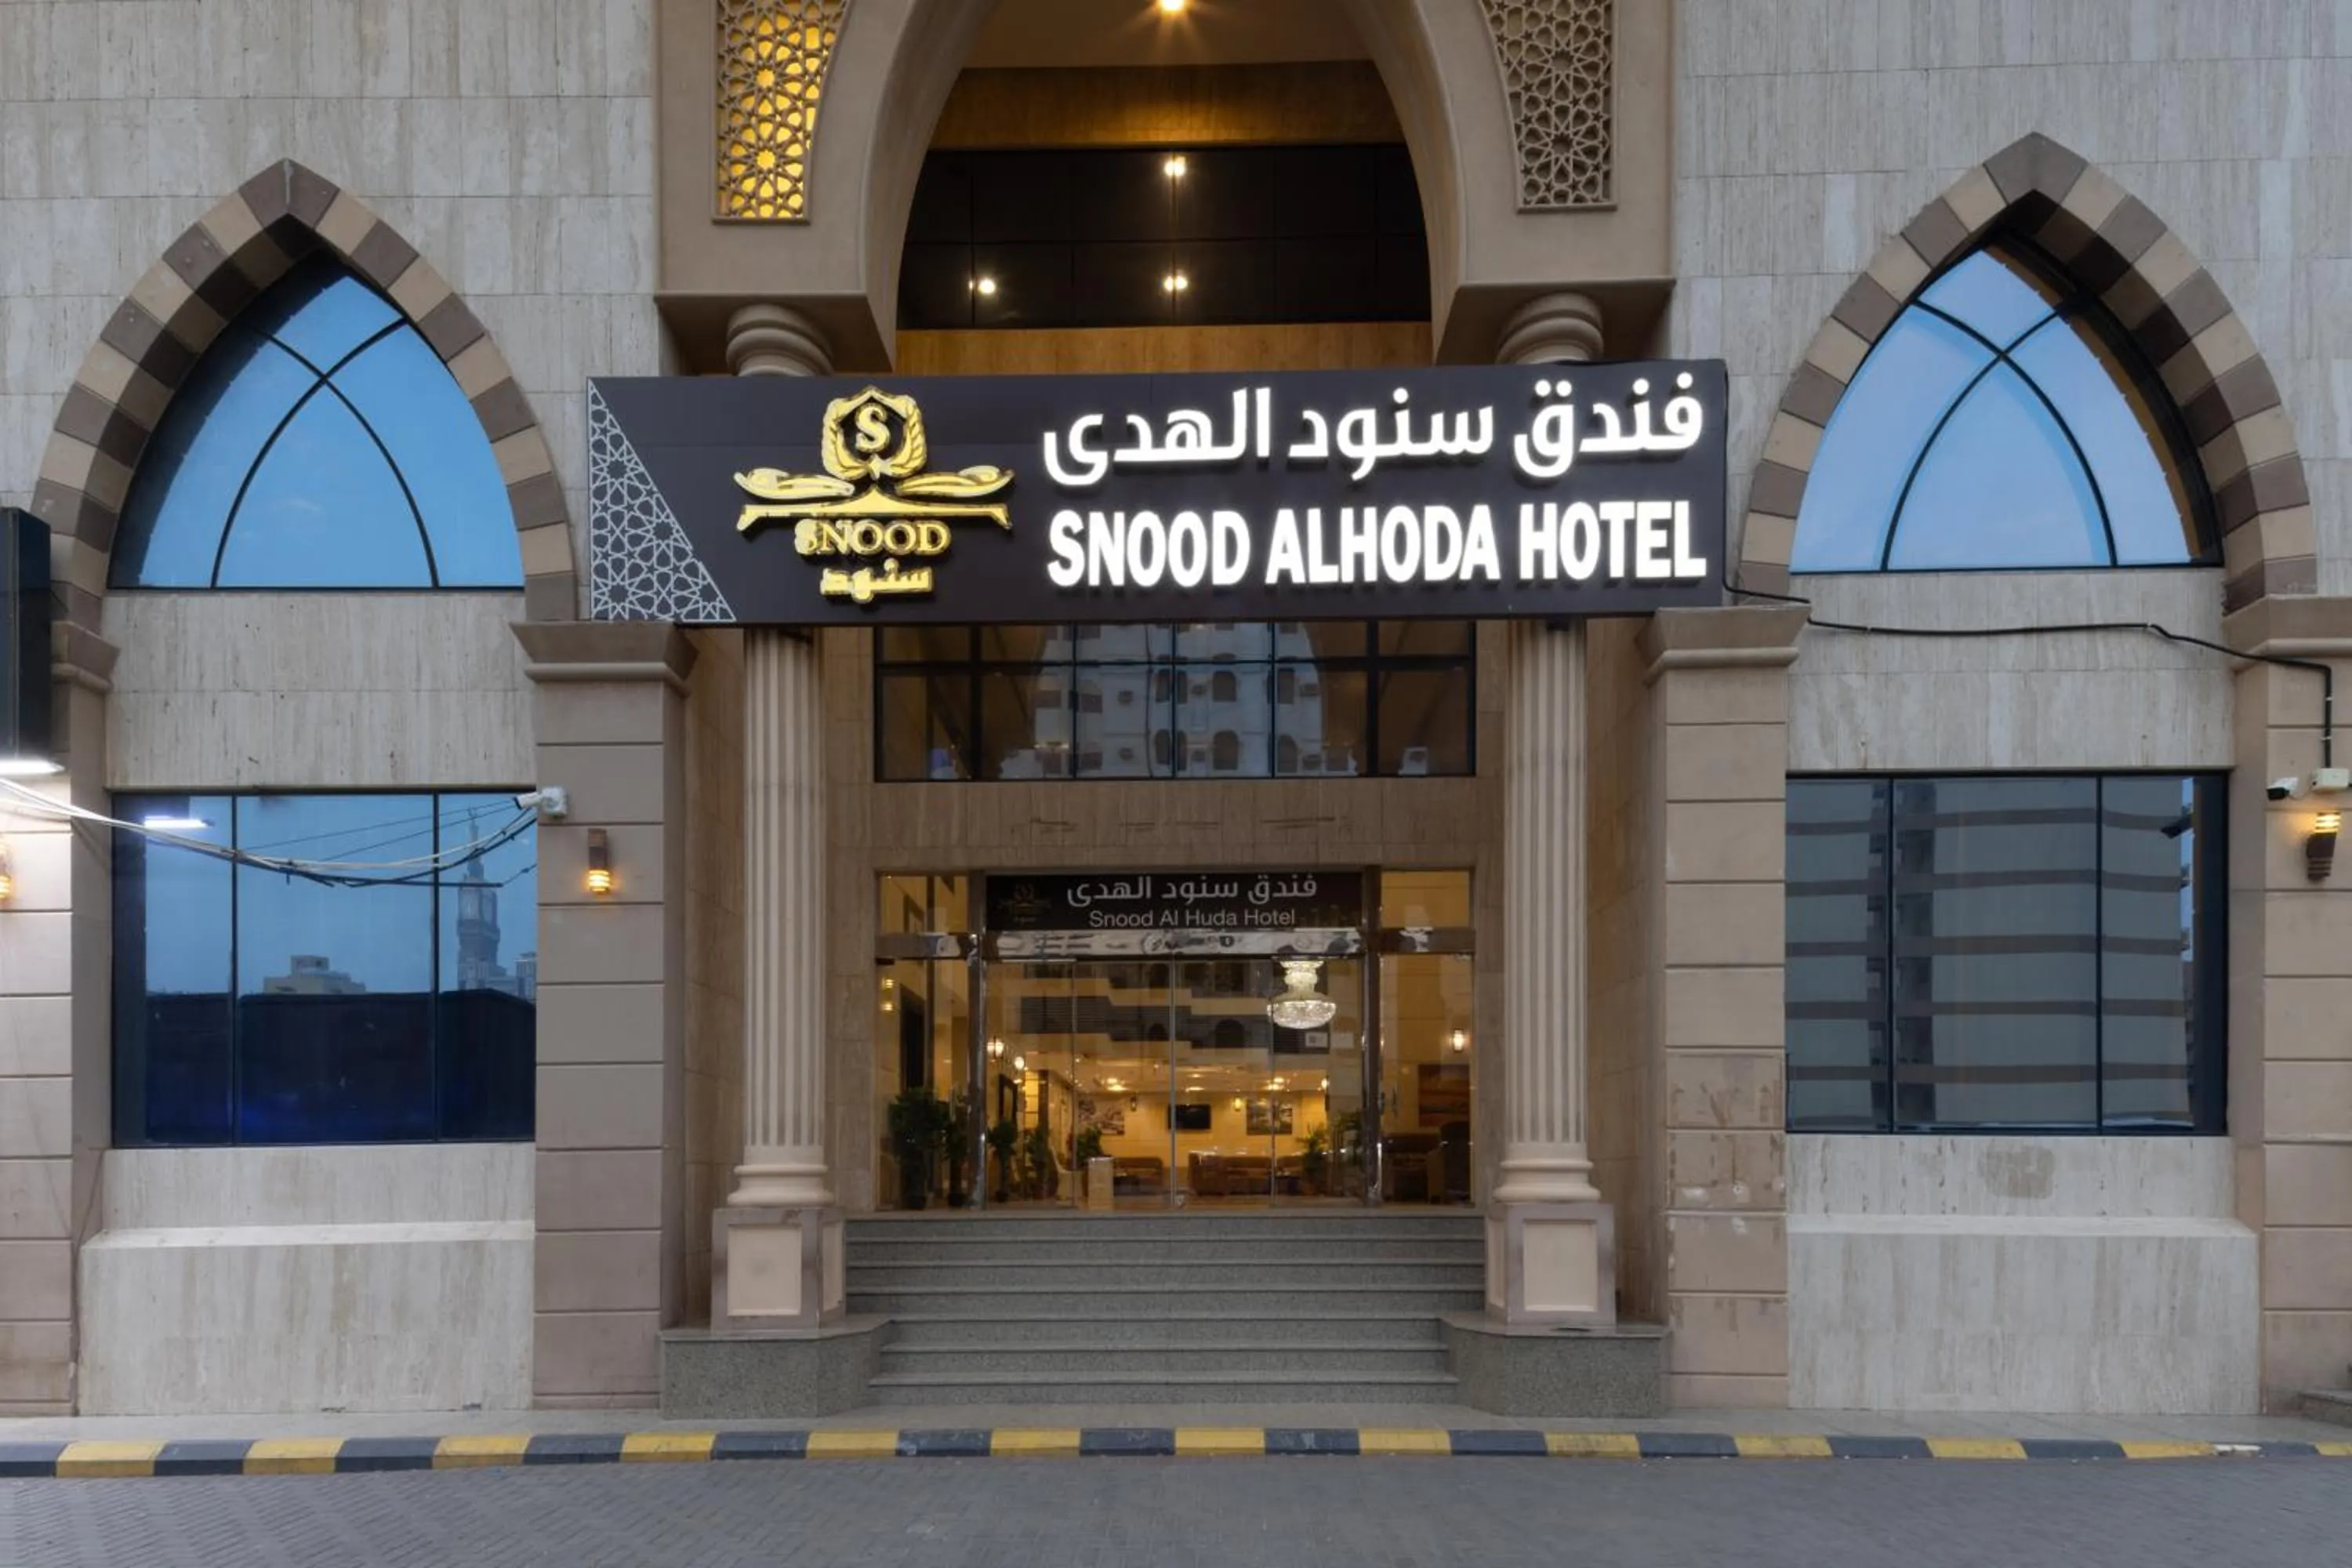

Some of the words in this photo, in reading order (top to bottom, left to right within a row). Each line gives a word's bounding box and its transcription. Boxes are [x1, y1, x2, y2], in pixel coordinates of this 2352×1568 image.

[855, 403, 891, 452] S
[1044, 387, 1271, 486] الهدى
[1288, 387, 1494, 481] سنود
[1513, 372, 1704, 478] فندق
[794, 518, 951, 555] SNOOD
[1047, 510, 1250, 587] SNOOD
[1265, 504, 1501, 584] ALHODA
[1519, 500, 1707, 580] HOTEL
[819, 557, 934, 604] سنود
[1067, 876, 1151, 907] الهدى
[1162, 876, 1238, 905] سنود
[1247, 874, 1317, 904] فندق
[1090, 910, 1153, 927] Snood
[1160, 910, 1178, 927] Al
[1185, 909, 1237, 926] Huda
[1244, 909, 1295, 925] Hotel
